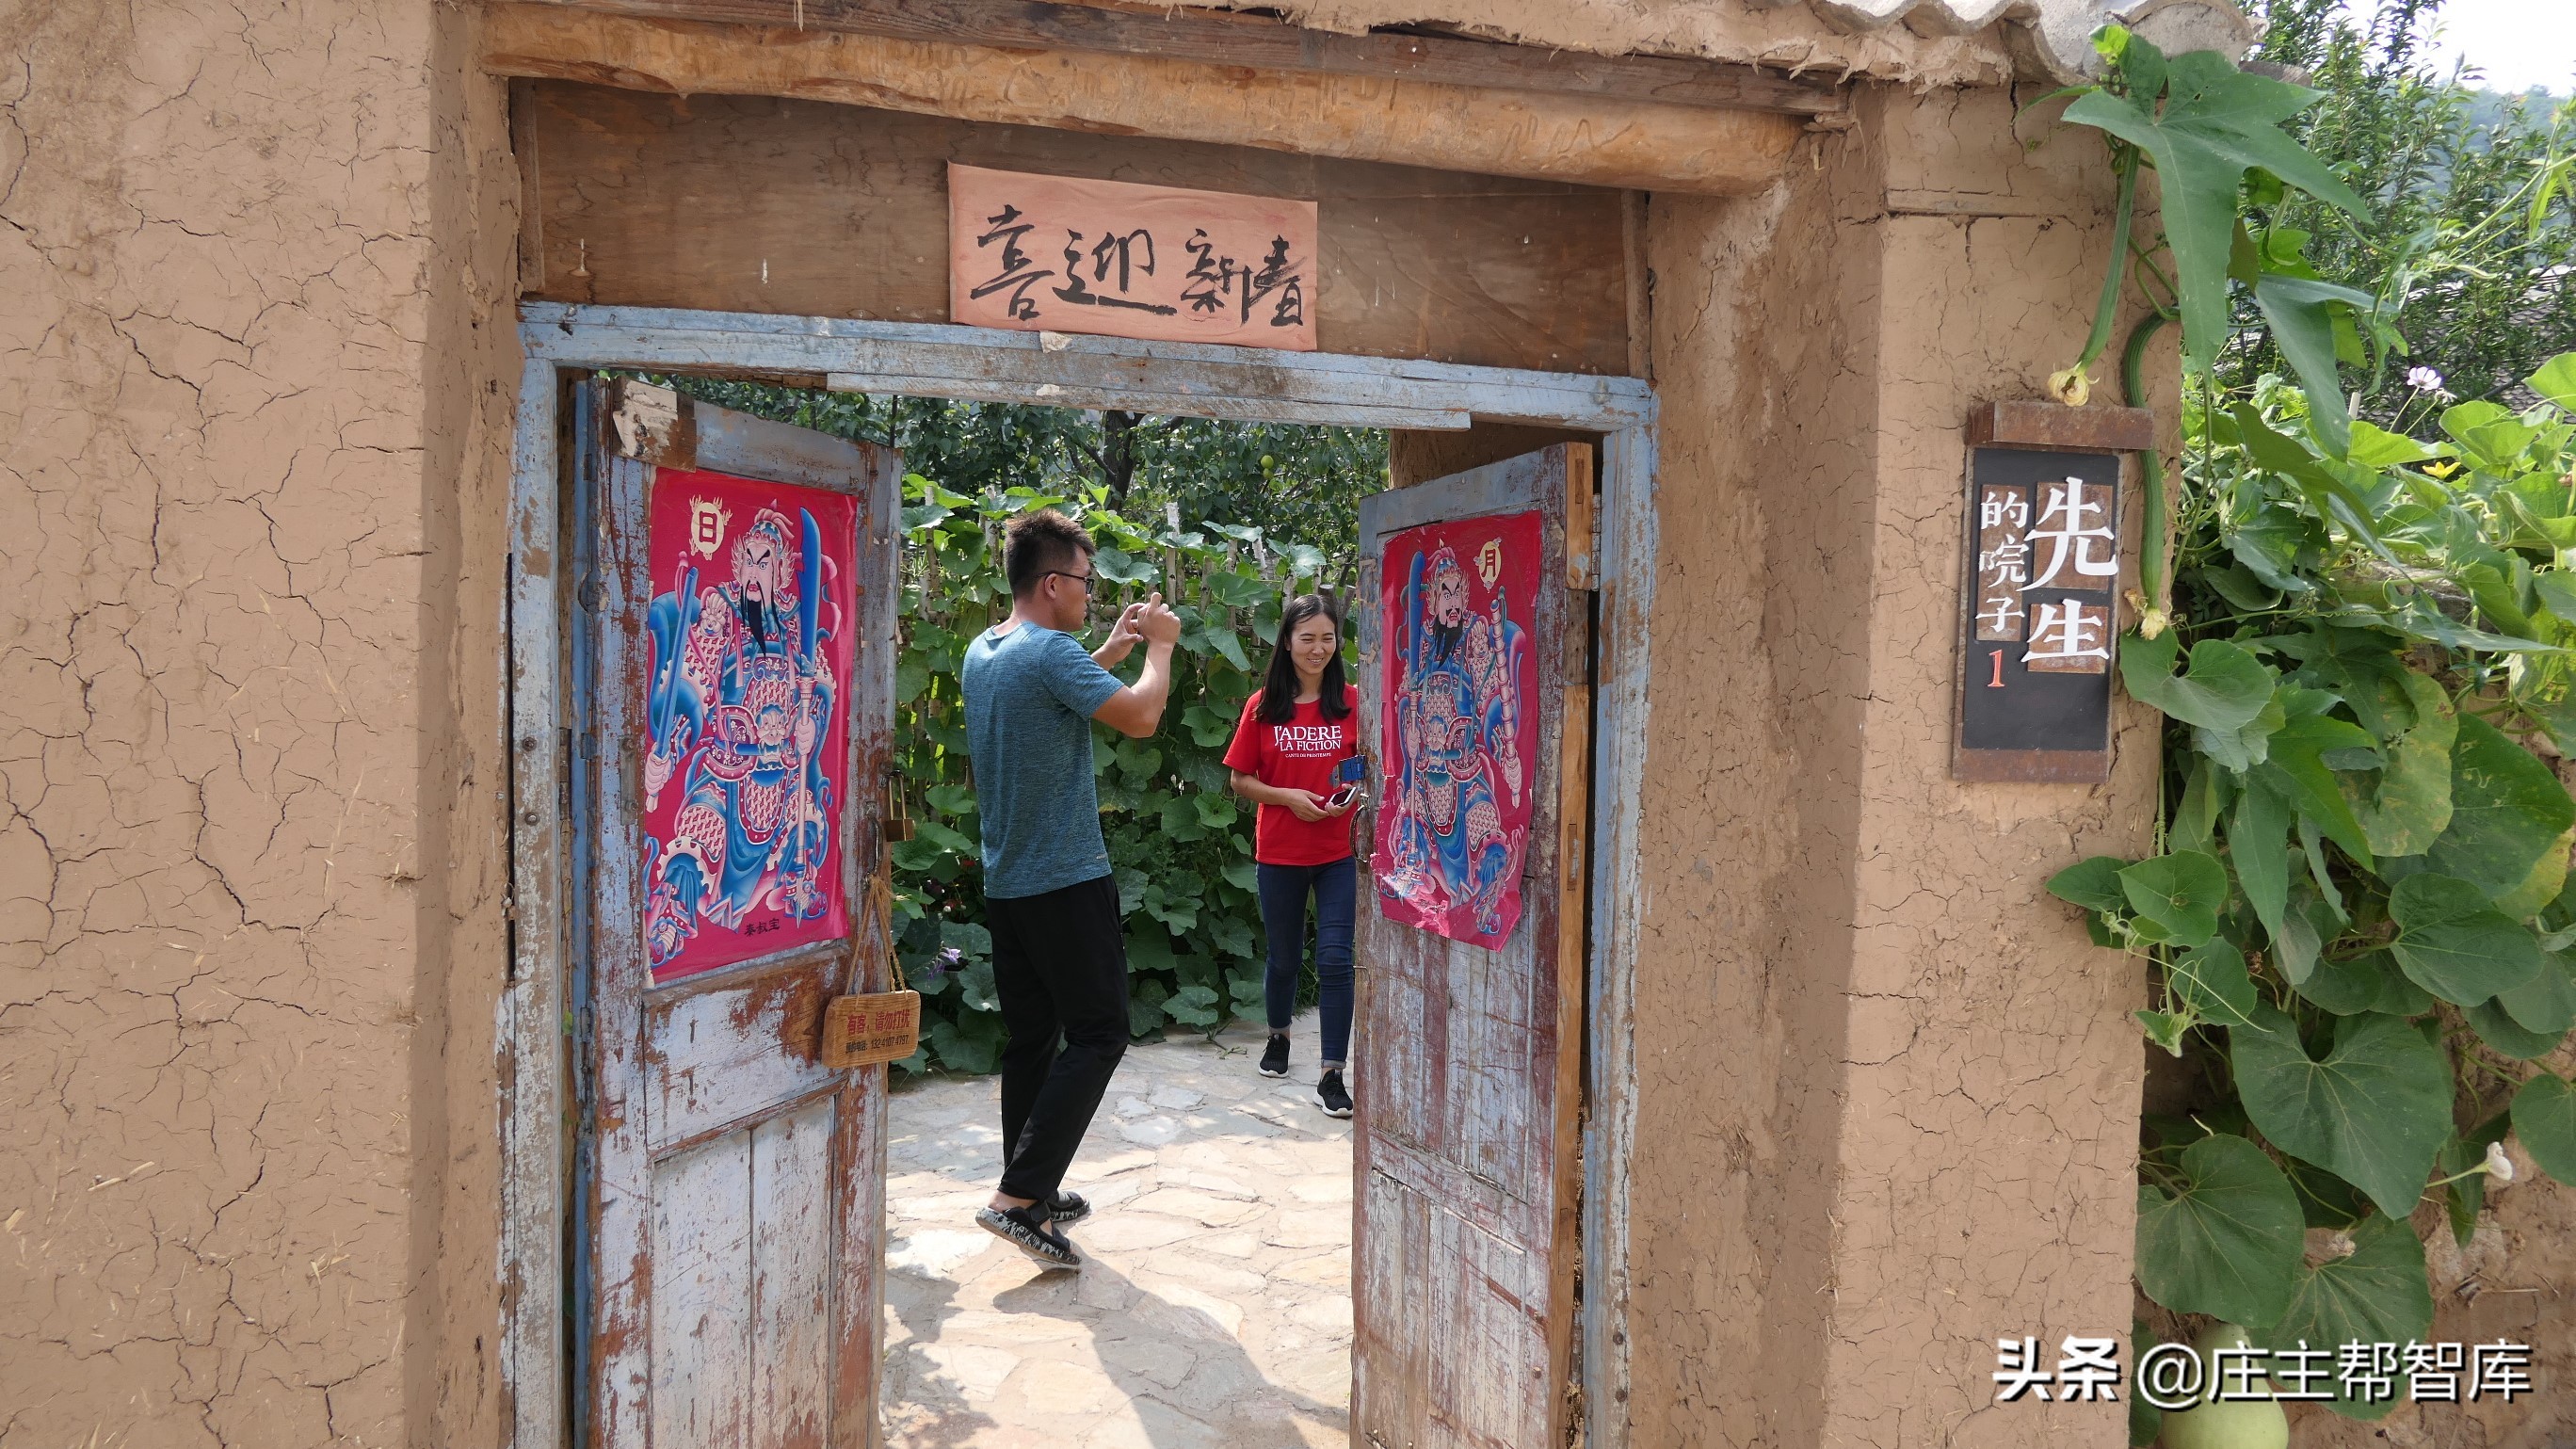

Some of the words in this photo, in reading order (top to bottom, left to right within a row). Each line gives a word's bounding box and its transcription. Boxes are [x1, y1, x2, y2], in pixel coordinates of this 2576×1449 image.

[699, 510, 717, 544] 日
[1481, 549, 1497, 578] 月
[1975, 491, 2029, 633] 的院子
[2016, 476, 2118, 662] 先生
[1988, 649, 2005, 687] 1
[1274, 725, 1342, 746] J'ADERE
[1280, 741, 1294, 751] LA
[1296, 740, 1341, 751] FICTION
[744, 918, 781, 937] 秦叔宝
